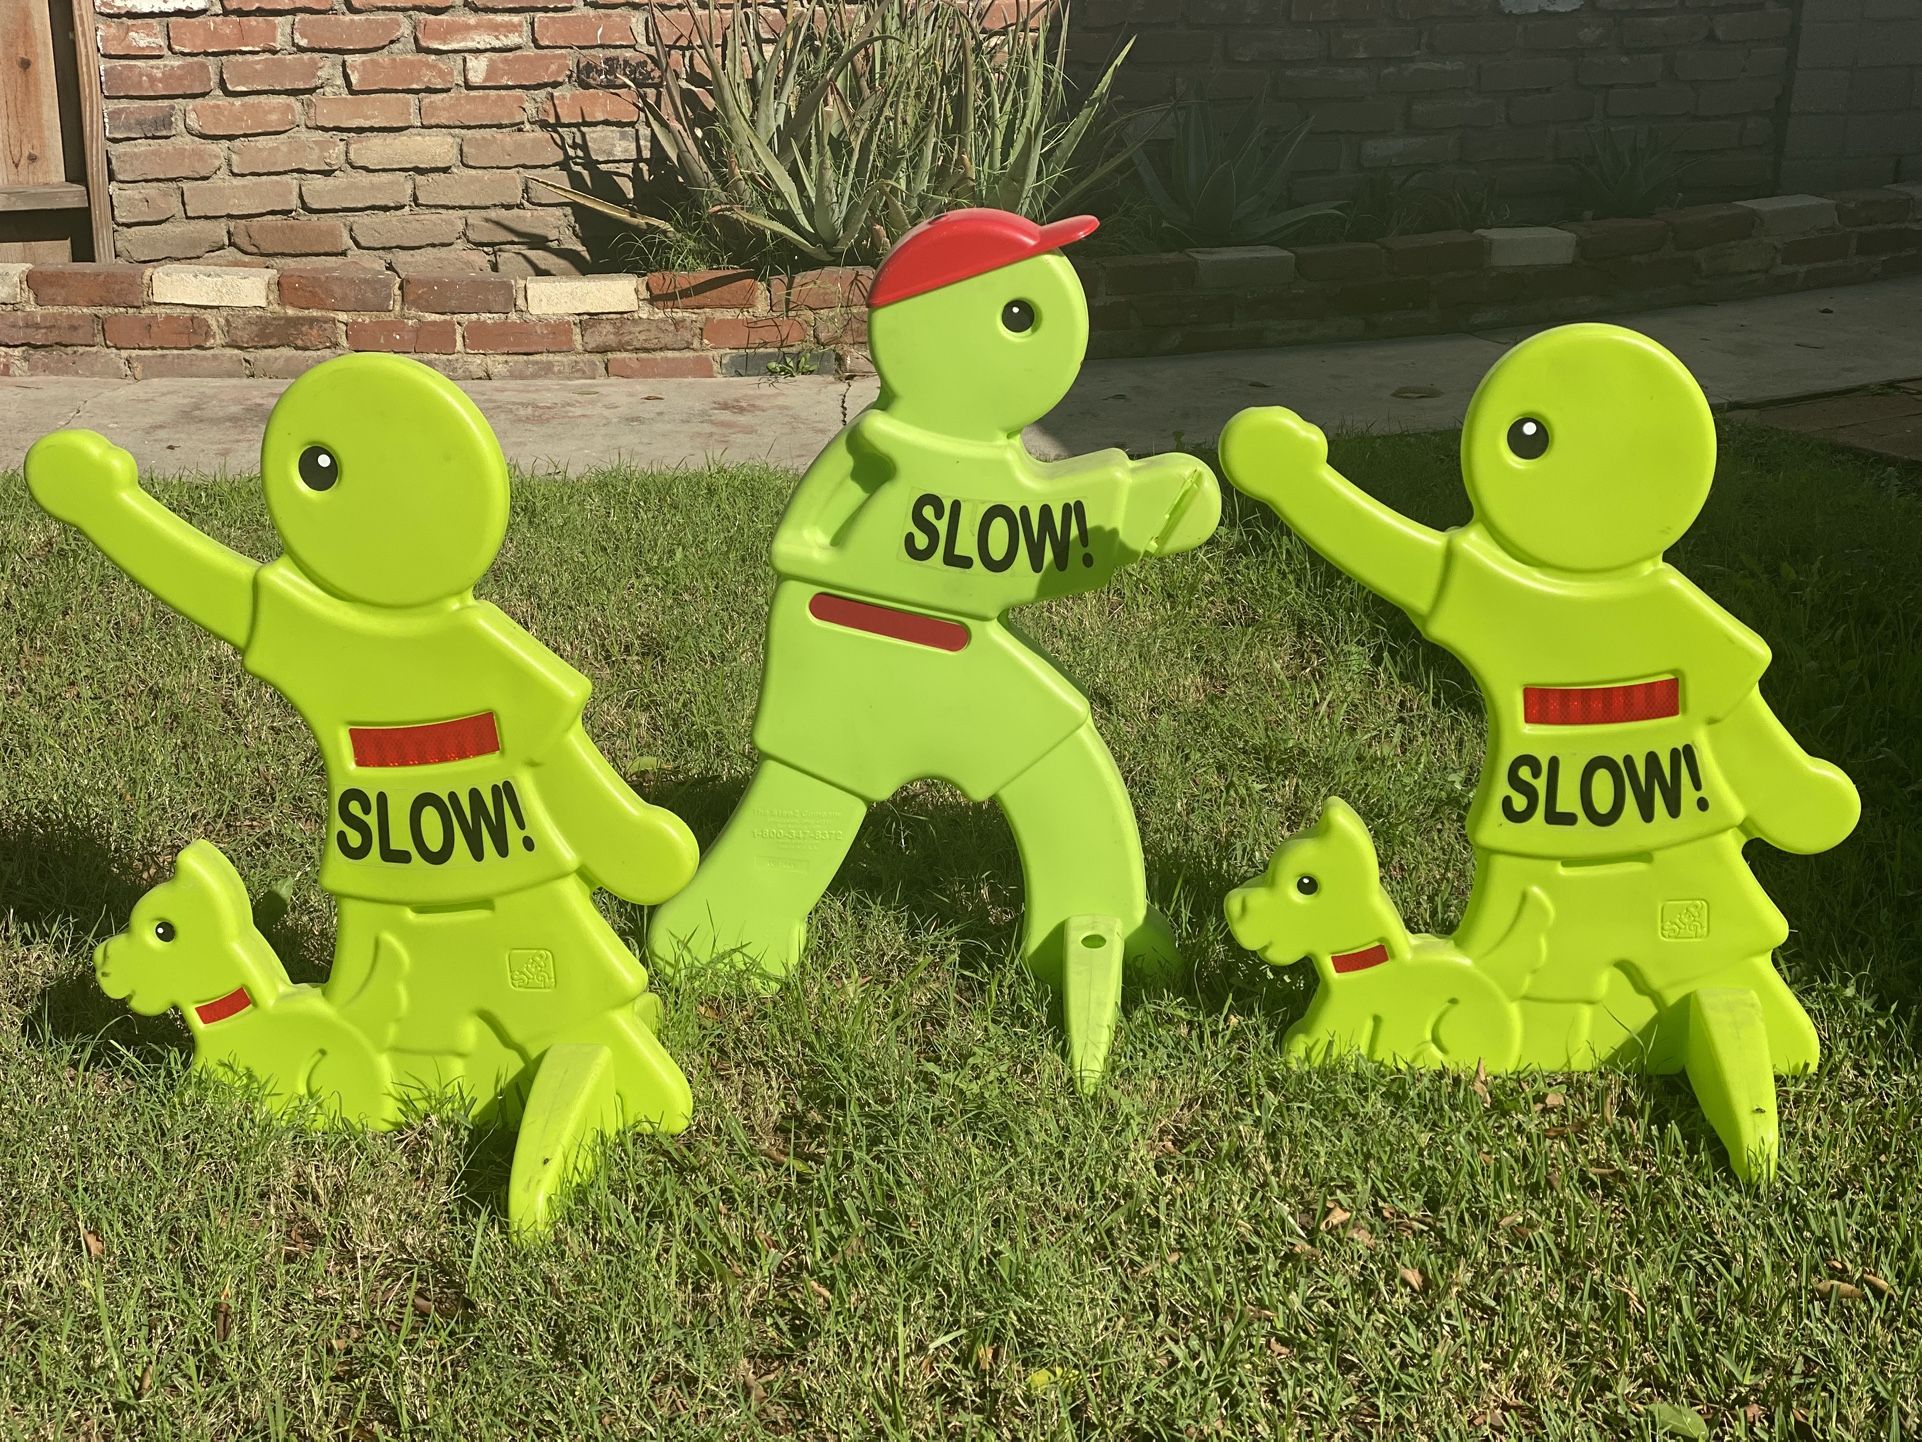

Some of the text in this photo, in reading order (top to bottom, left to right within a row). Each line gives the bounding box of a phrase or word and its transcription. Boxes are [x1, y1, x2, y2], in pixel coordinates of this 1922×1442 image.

[904, 493, 1095, 574] SLOW!
[336, 780, 535, 866] SLOW!
[1502, 743, 1710, 828] SLOW!
